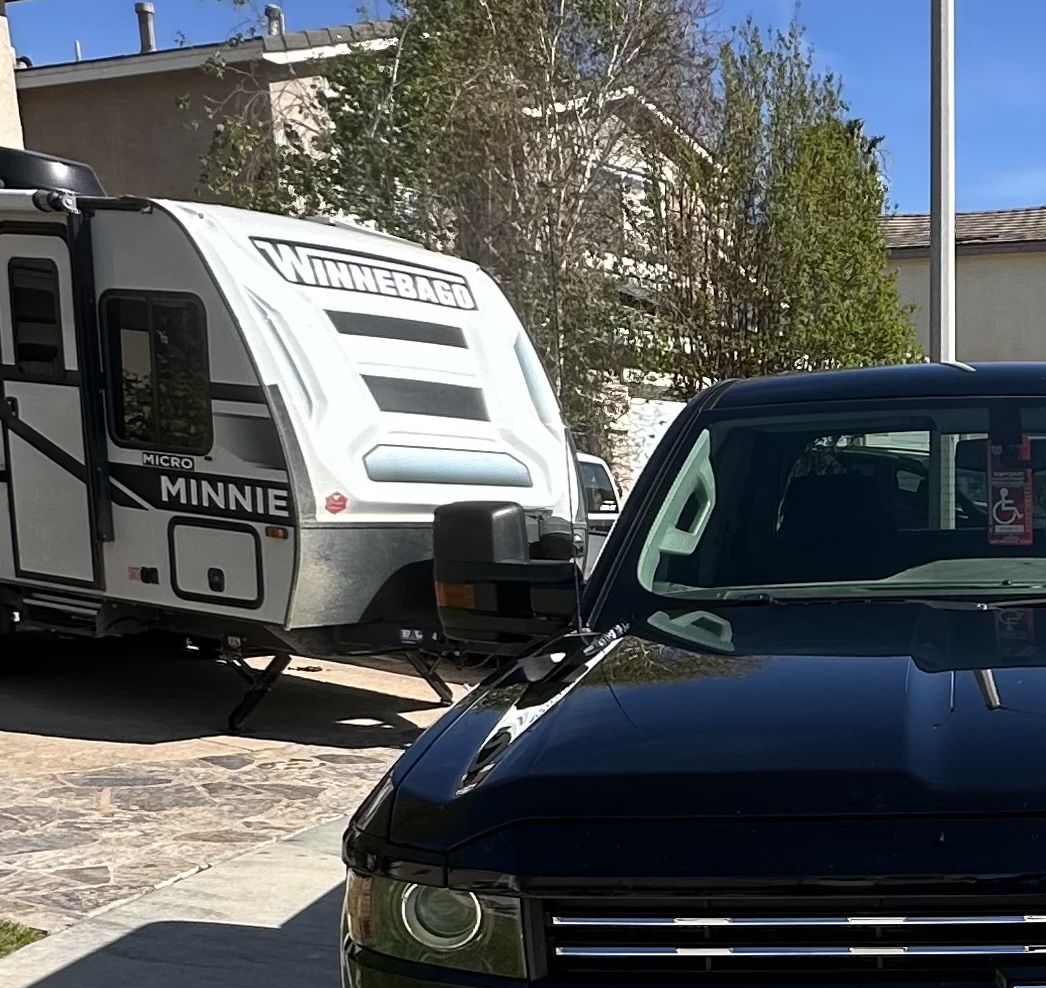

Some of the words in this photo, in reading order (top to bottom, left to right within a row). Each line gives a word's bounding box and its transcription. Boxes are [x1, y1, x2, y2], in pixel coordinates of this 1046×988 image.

[255, 240, 476, 309] WINNEBAGO
[143, 454, 194, 469] MICRO
[160, 475, 289, 518] MINNIE
